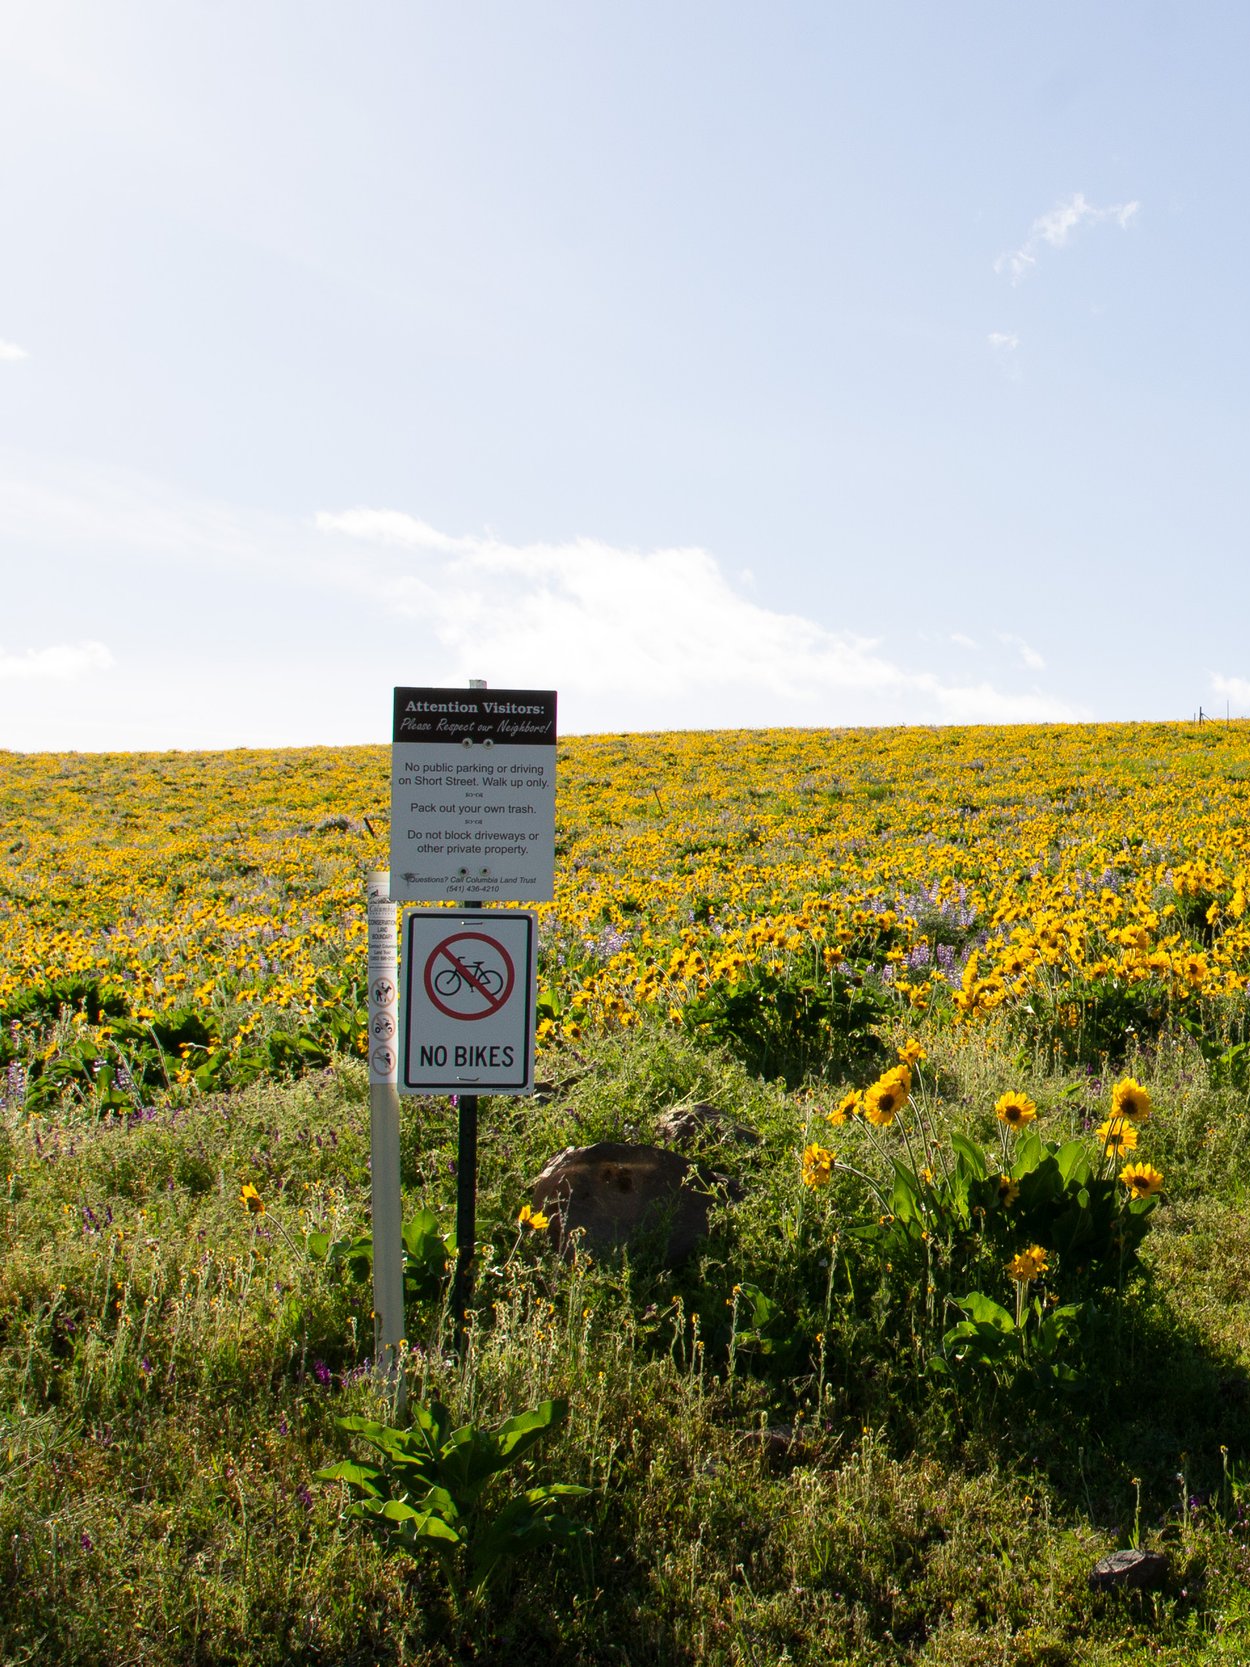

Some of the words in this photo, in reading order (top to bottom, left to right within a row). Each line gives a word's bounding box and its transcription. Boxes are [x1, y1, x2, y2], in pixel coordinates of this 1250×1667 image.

[405, 700, 478, 713] Attention
[482, 702, 545, 714] Visitors:
[400, 717, 432, 731] Please
[436, 718, 475, 735] Respect
[497, 719, 552, 737] Neighbors!
[405, 762, 420, 772] No
[423, 762, 454, 774] public
[456, 763, 494, 775] parking
[497, 765, 507, 773] or
[510, 763, 544, 776] driving
[398, 777, 412, 785] on
[414, 776, 442, 786] Short
[445, 776, 479, 786] Street.
[482, 777, 507, 787] Walk
[510, 779, 523, 788] up
[526, 778, 549, 789] only.
[410, 802, 436, 813] Pack
[439, 803, 455, 813] out
[458, 805, 482, 815] your
[484, 805, 505, 813] own
[508, 804, 536, 814] trash.
[407, 830, 423, 840] Do
[425, 830, 442, 840] not
[444, 830, 472, 840] block
[475, 831, 526, 842] driveways
[528, 832, 540, 840] or
[417, 844, 444, 853] other
[446, 844, 481, 855] private
[484, 845, 529, 855] property.
[409, 876, 448, 884] Questions?
[450, 876, 463, 884] Call
[465, 876, 498, 884] Columbia
[446, 885, 465, 893] (541)
[467, 885, 499, 893] 436-4210
[420, 1045, 448, 1067] NO
[454, 1045, 514, 1067] BIKES
